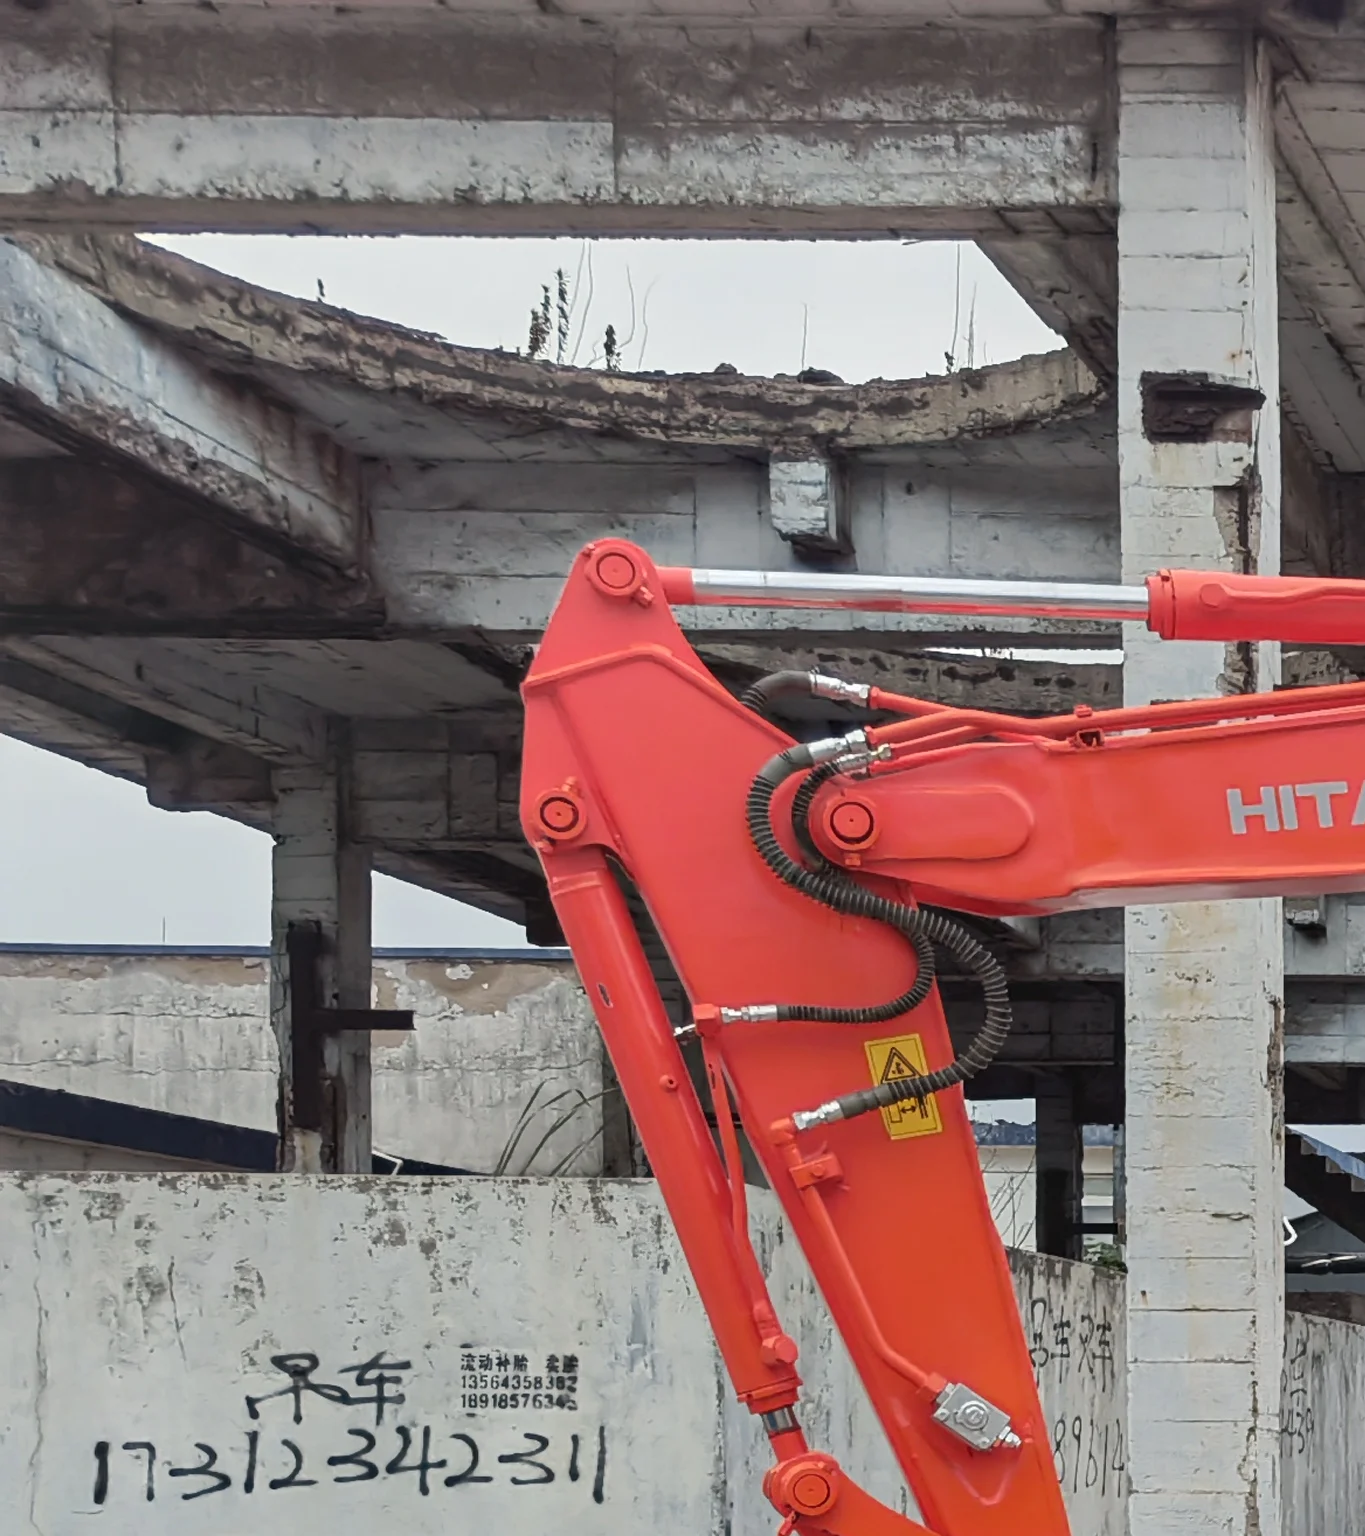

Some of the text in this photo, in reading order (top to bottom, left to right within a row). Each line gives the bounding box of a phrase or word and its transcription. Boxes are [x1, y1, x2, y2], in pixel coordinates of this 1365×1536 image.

[460, 1353, 529, 1373] 流动补胎
[93, 1425, 606, 1504] 17312342311
